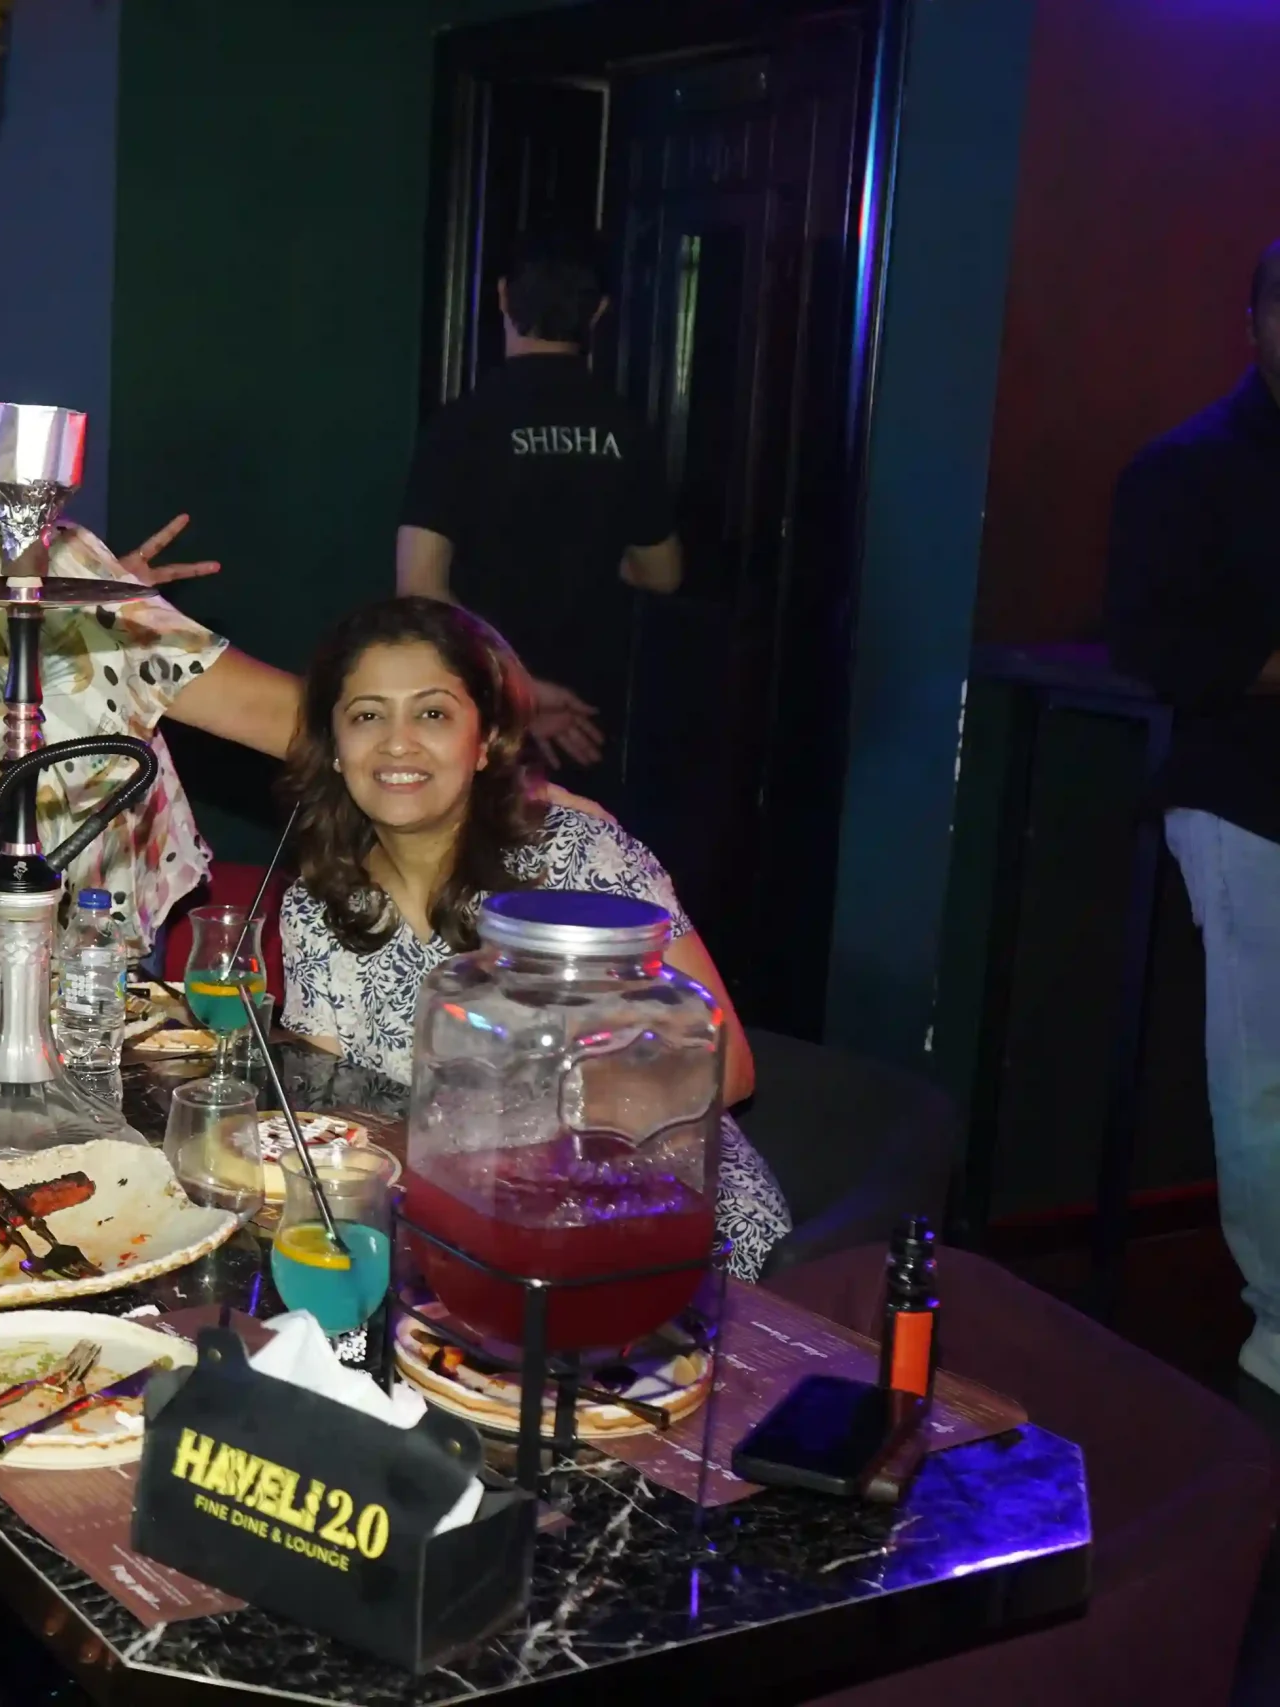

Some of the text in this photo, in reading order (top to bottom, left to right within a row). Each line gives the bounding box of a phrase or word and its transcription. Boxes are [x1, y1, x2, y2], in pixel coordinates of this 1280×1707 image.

[510, 426, 622, 459] SHISHA
[194, 1493, 350, 1571] FINE DINE & LOUNGE
[319, 1488, 389, 1559] 2.0
